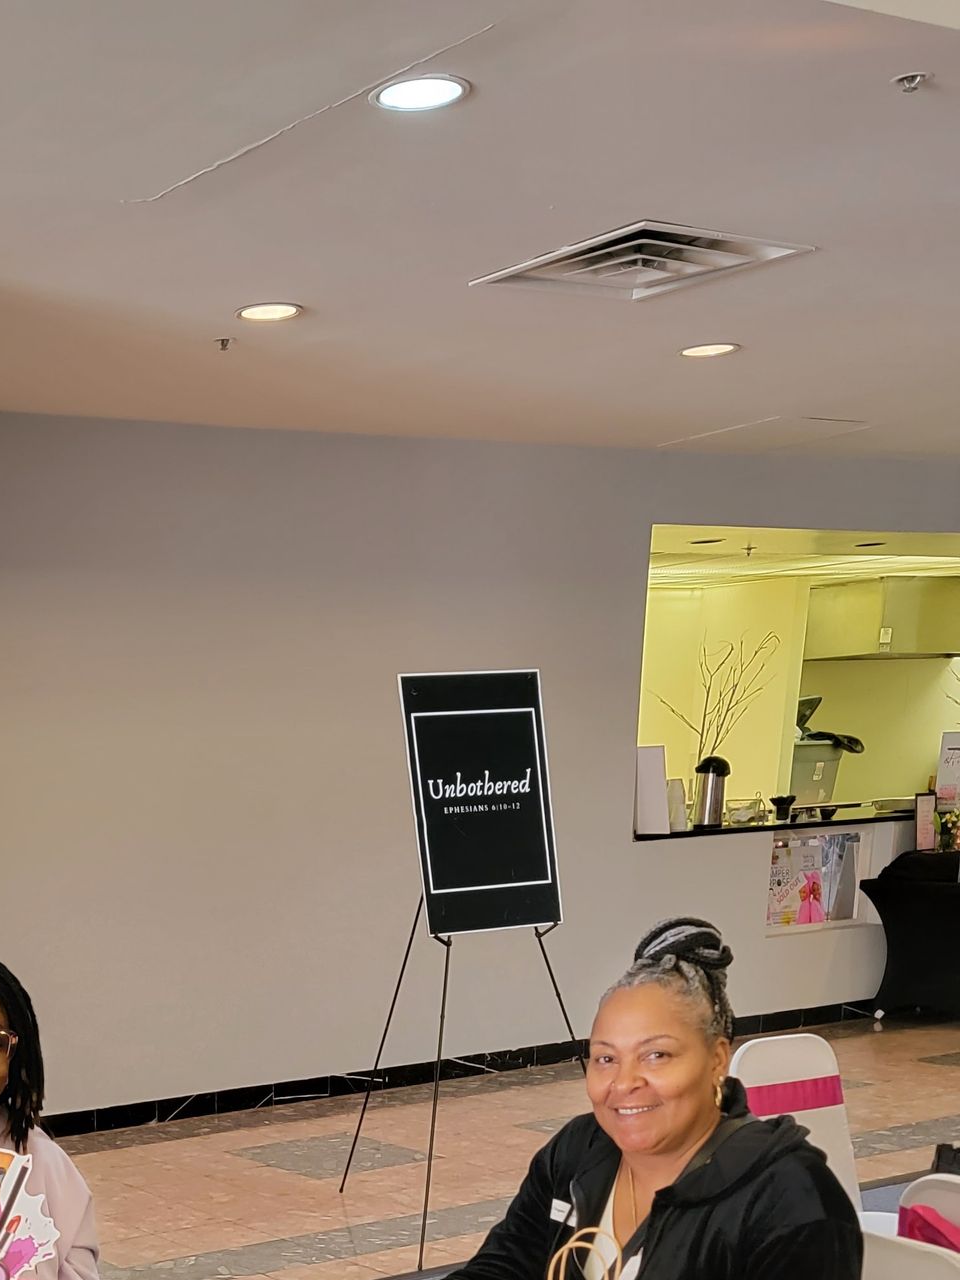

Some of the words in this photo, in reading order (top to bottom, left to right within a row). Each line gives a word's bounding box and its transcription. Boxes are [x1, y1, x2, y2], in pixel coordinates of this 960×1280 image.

[428, 768, 531, 799] Unbothered
[444, 804, 489, 814] EPHESIANS
[776, 888, 790, 904] SOLD
